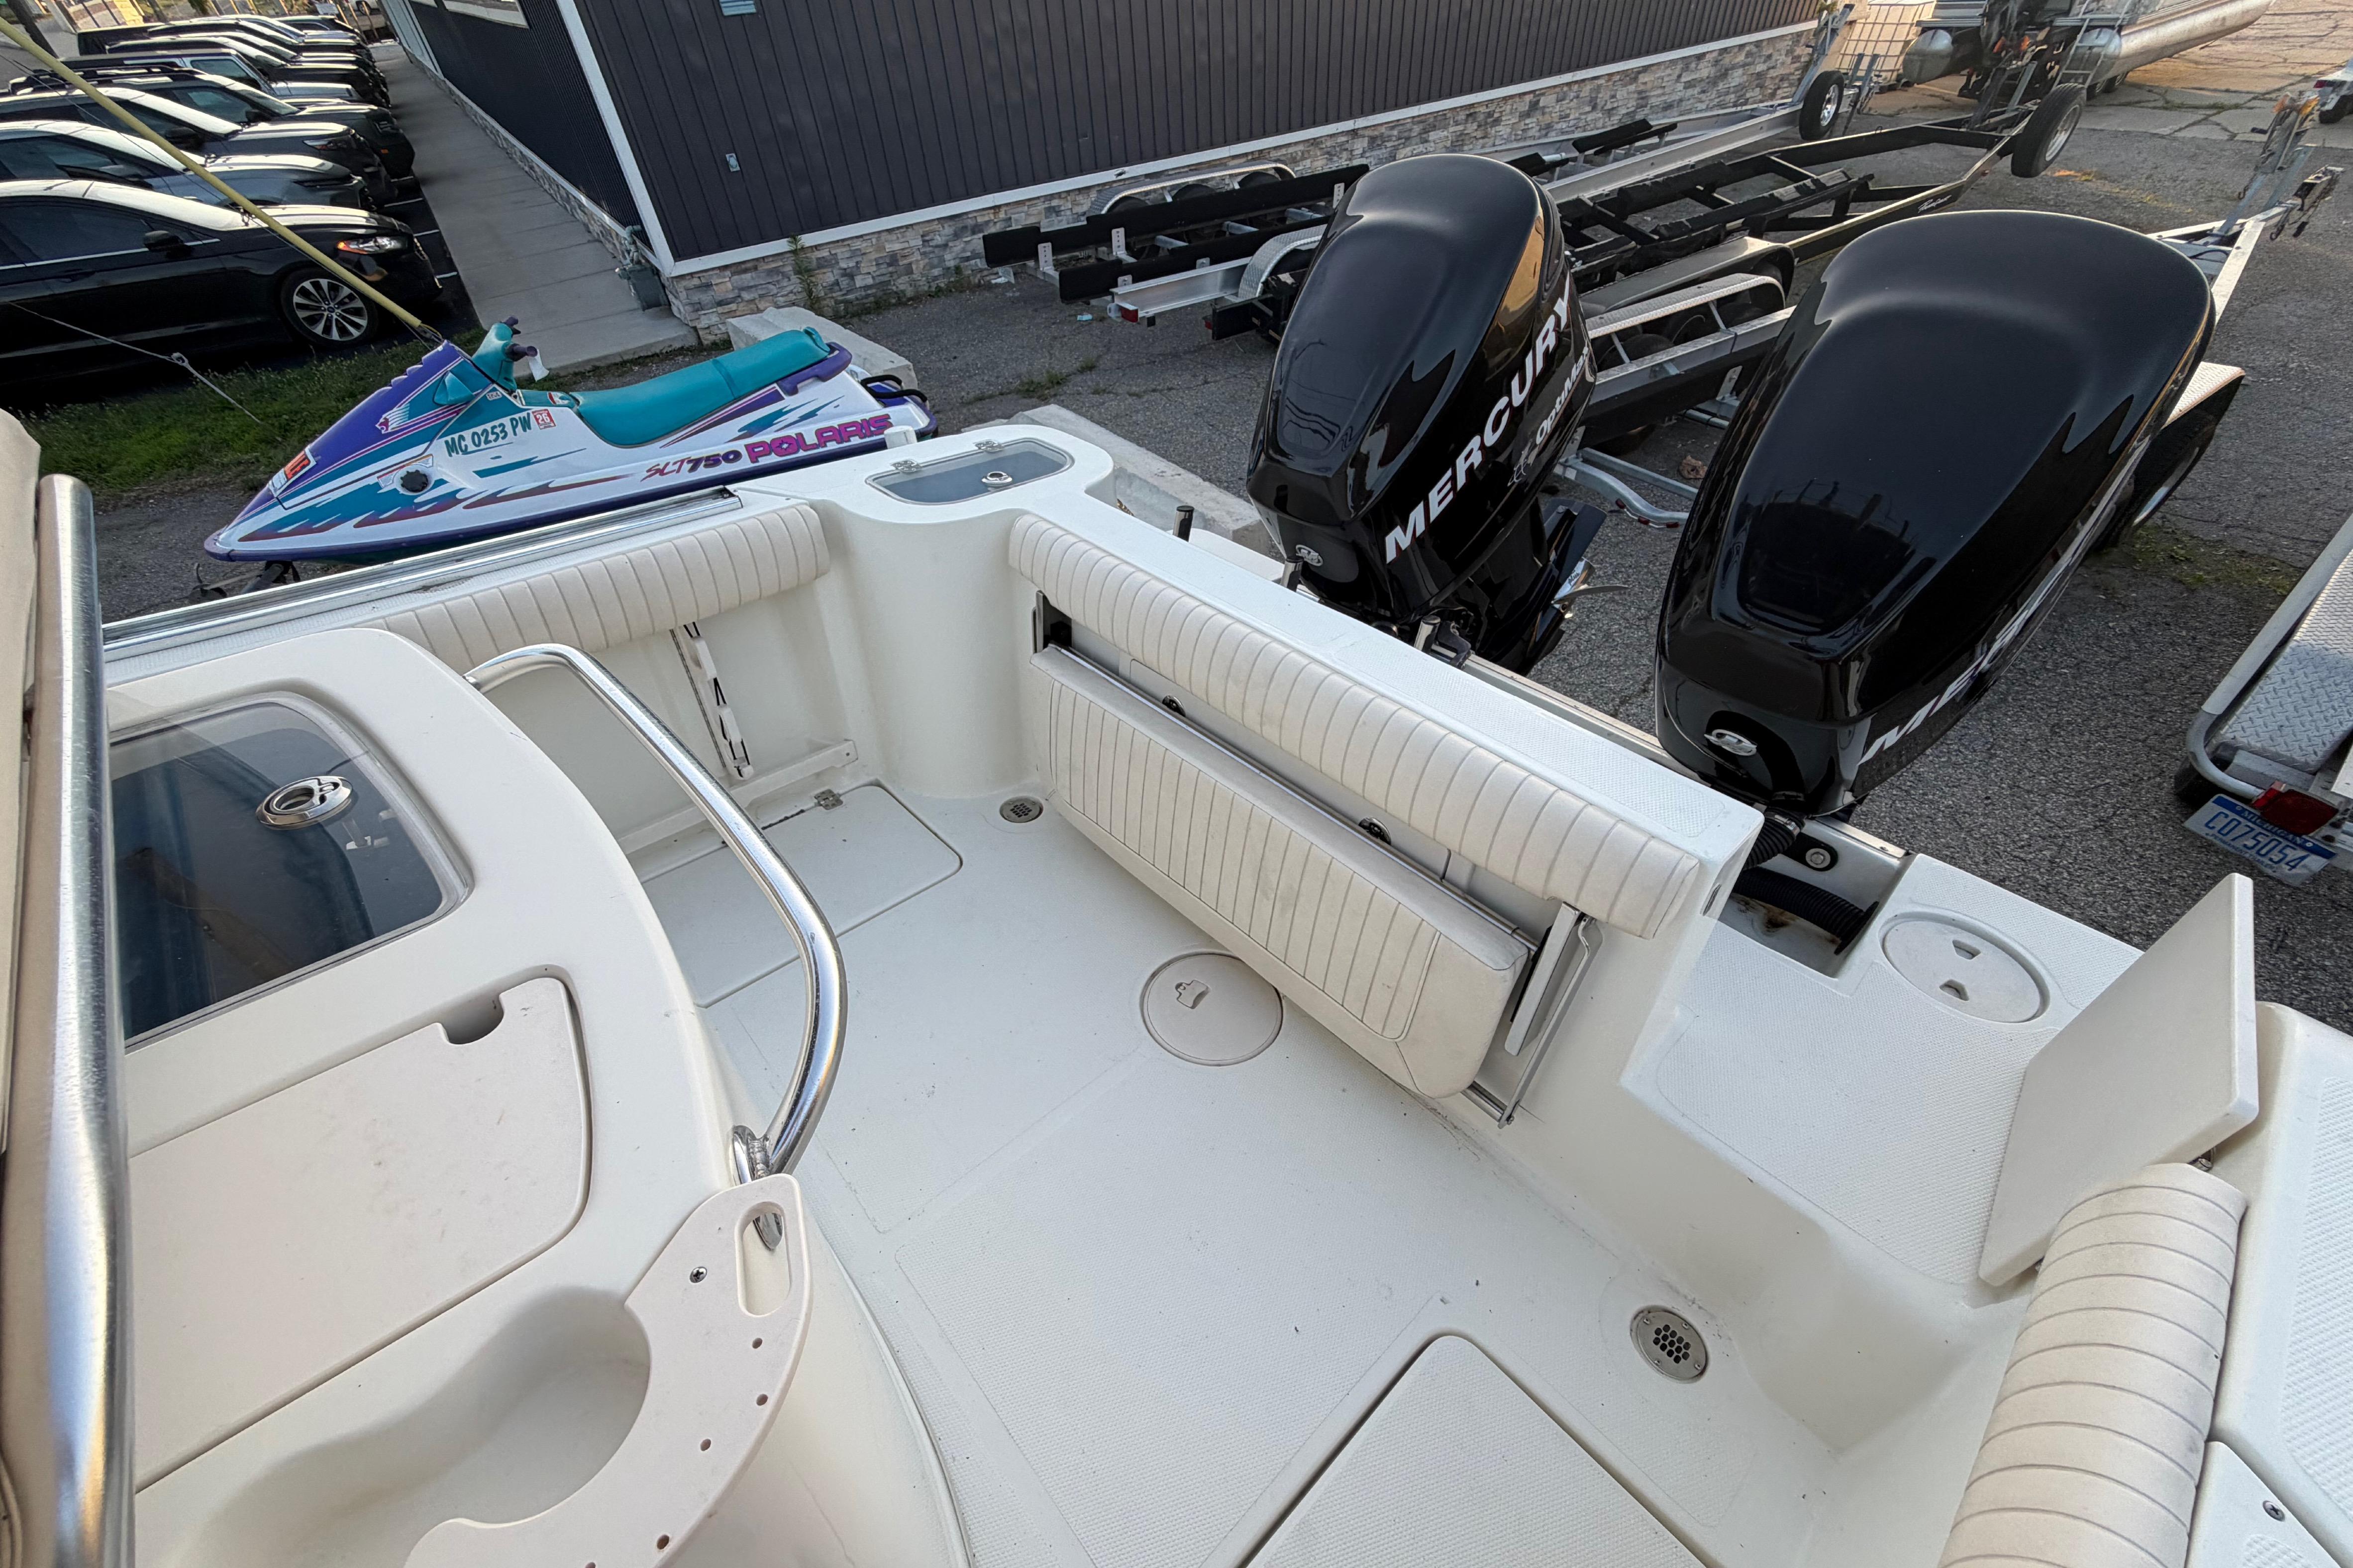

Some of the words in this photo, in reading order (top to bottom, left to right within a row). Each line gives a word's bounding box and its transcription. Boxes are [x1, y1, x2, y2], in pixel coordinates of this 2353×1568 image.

[444, 434, 469, 457] MC
[471, 422, 508, 448] 0253
[509, 412, 532, 436] PW
[536, 412, 551, 424] 26
[744, 413, 894, 464] POLARIS
[1386, 270, 1570, 564] MERCURY
